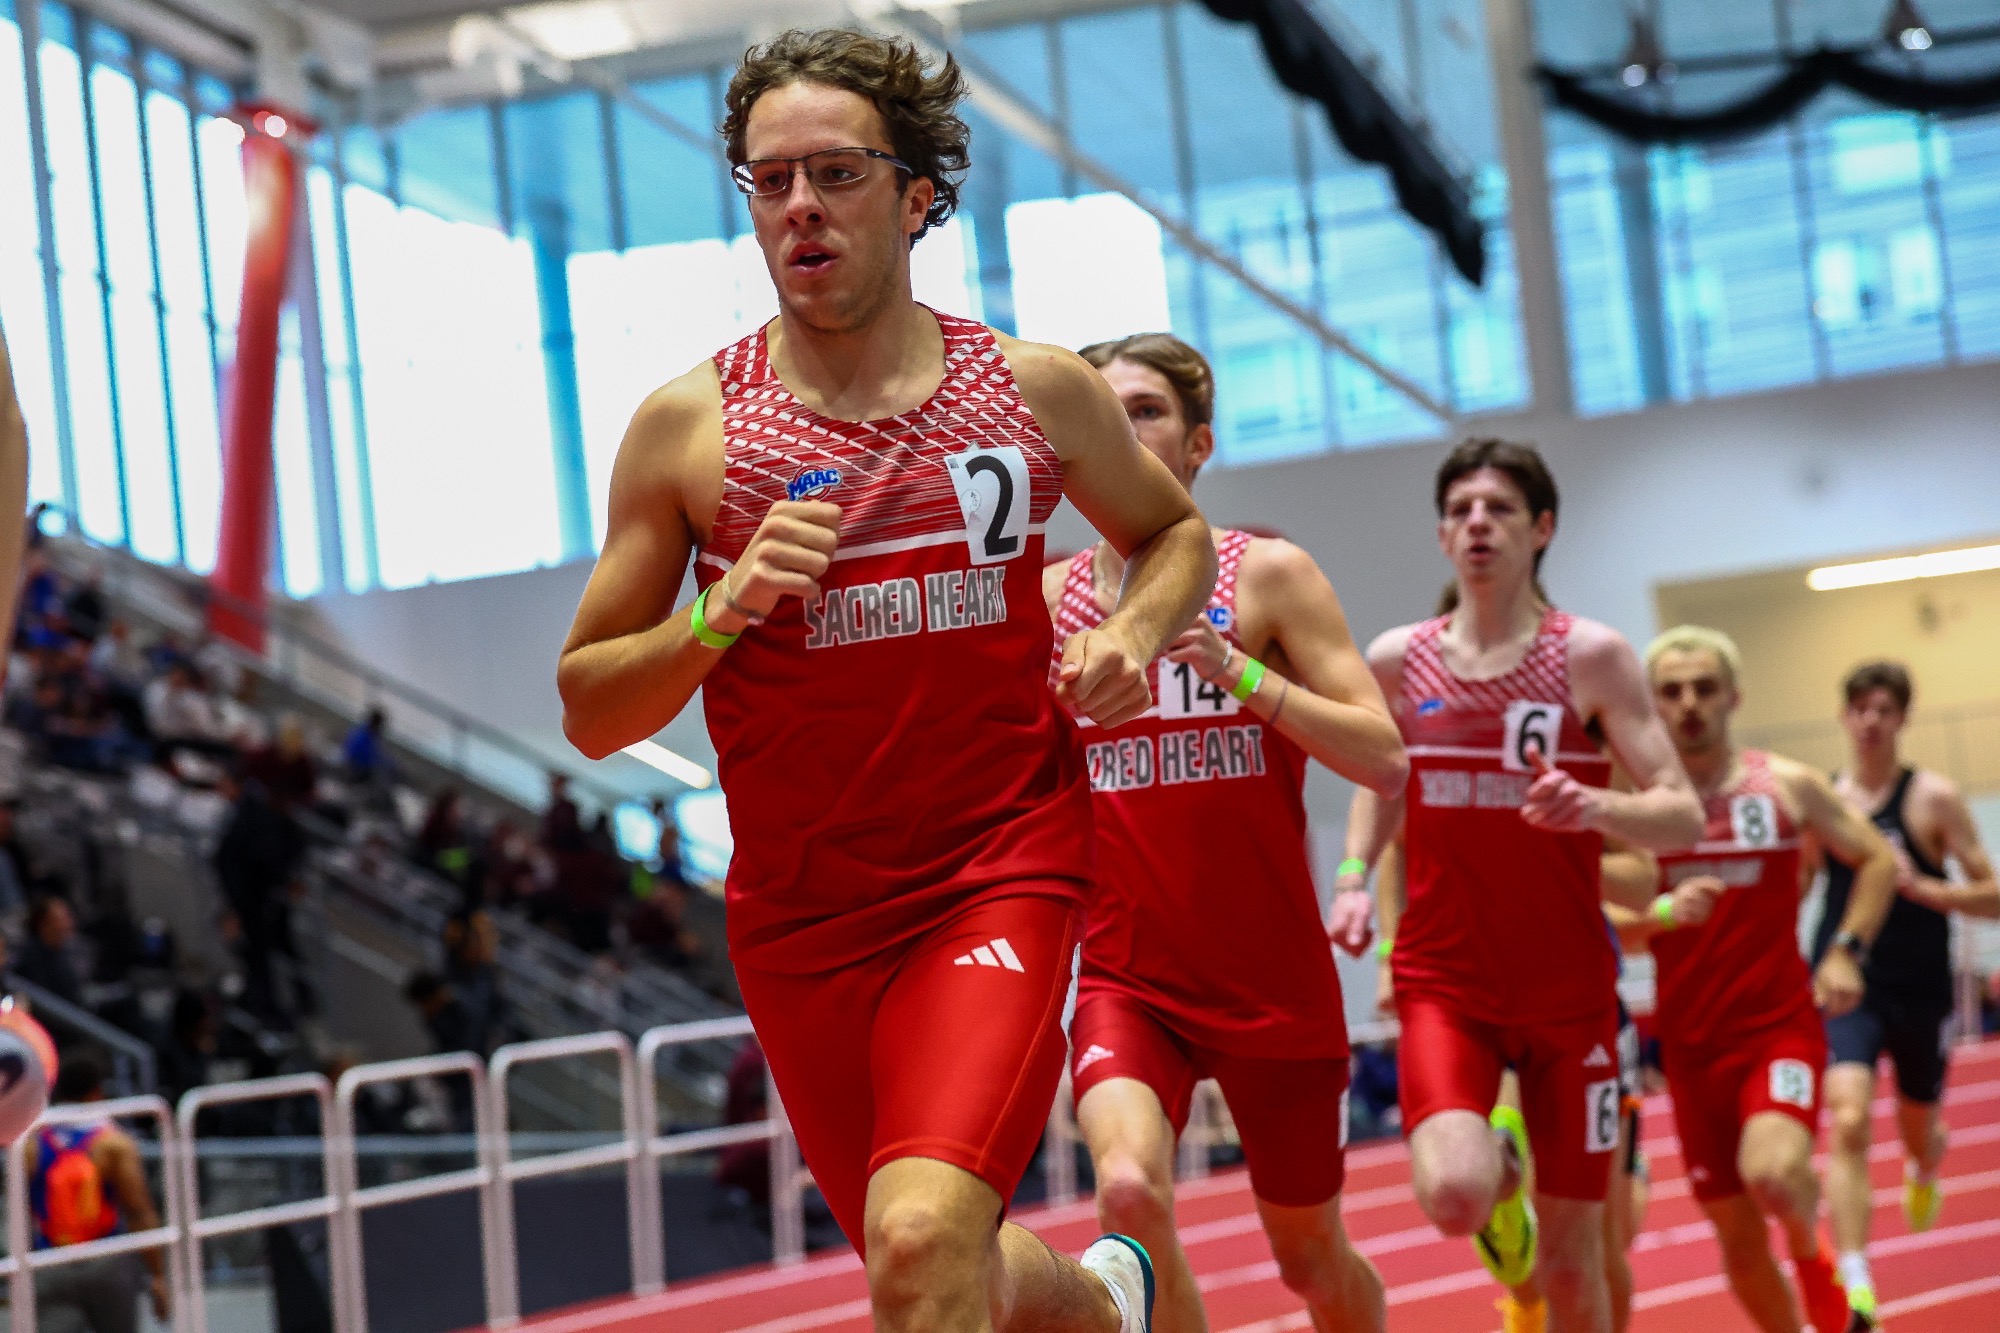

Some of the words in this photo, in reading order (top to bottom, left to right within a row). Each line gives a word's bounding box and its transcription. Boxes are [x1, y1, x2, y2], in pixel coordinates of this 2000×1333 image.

[786, 468, 839, 502] MAAC
[965, 454, 1018, 557] 2
[803, 577, 922, 650] SACRED
[924, 565, 1007, 633] HEART
[1173, 662, 1227, 713] 14
[1086, 735, 1155, 792] CRED
[1159, 724, 1266, 786] HEART
[1517, 709, 1547, 769] 6
[1741, 798, 1767, 843] 8
